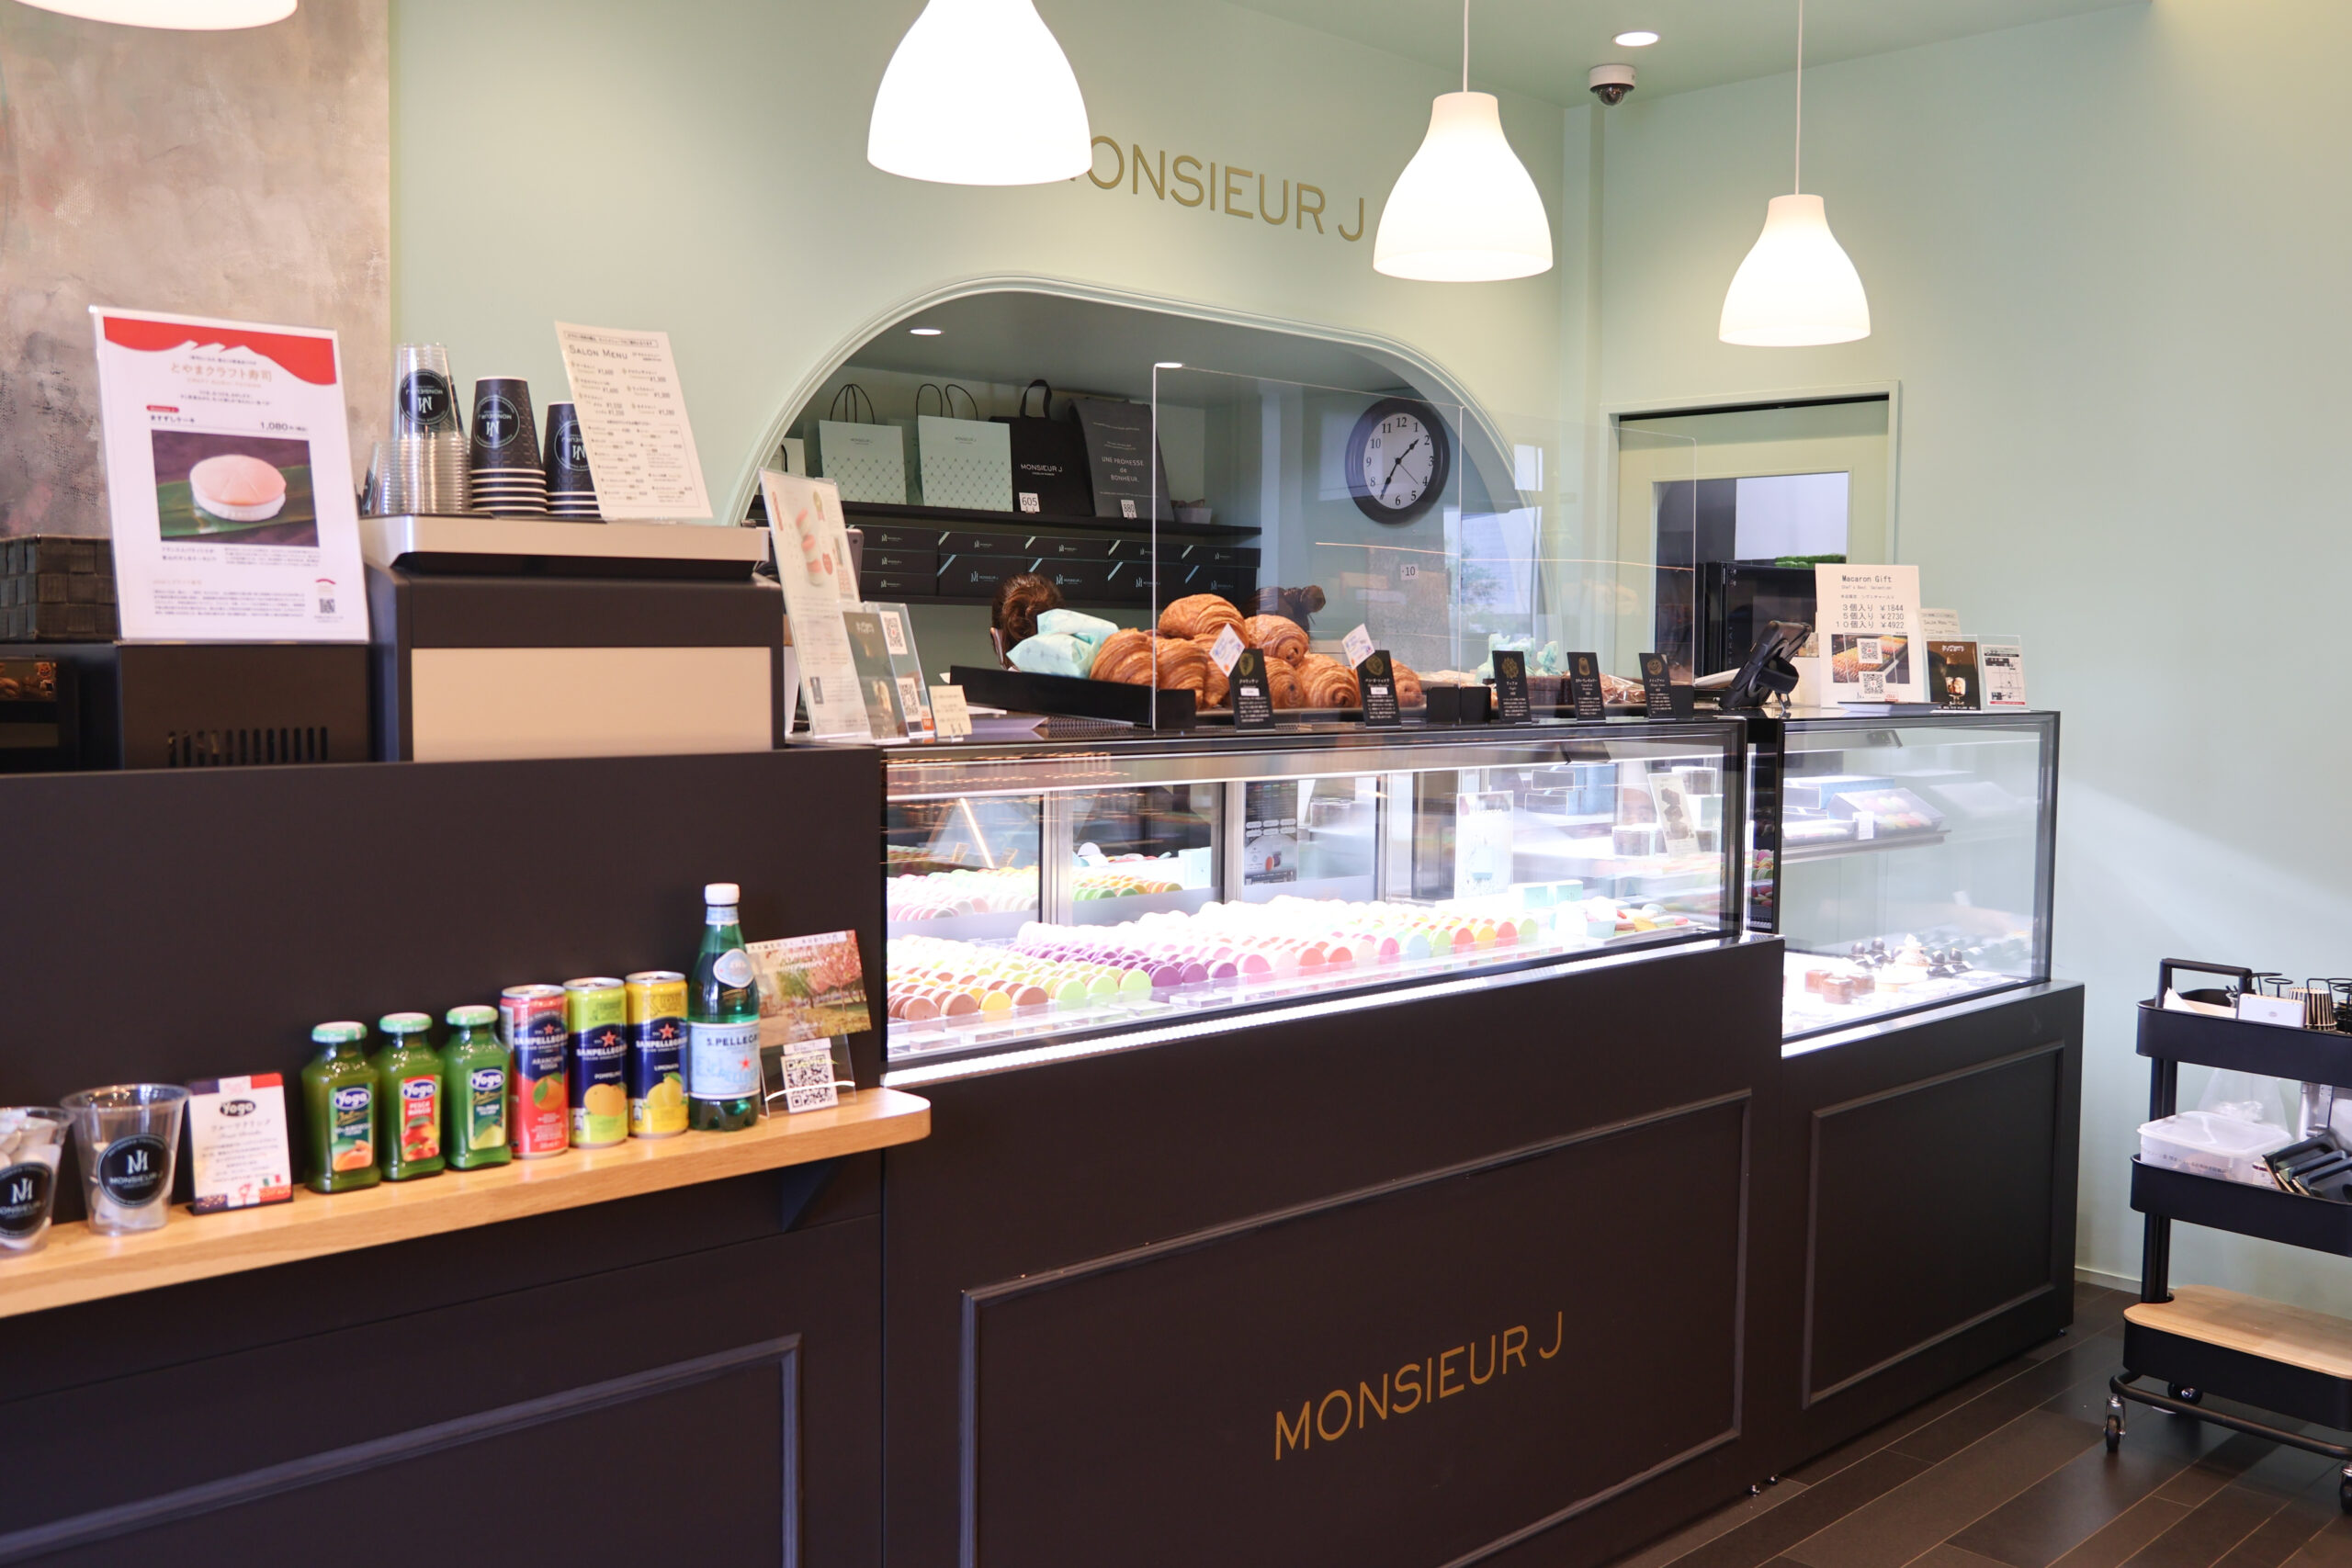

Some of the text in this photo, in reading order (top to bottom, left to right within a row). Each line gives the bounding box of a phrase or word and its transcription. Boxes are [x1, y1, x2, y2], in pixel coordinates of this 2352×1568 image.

[1070, 135, 1364, 242] ONSIEUR J
[1396, 417, 1408, 428] 12
[1413, 423, 1419, 433] 1
[1382, 423, 1392, 434] 11
[1371, 438, 1382, 449] 10
[1424, 434, 1430, 446] 2
[1366, 457, 1372, 467] 9
[1428, 456, 1433, 467] 3
[1021, 463, 1057, 472] MONSIEUR
[1370, 477, 1375, 487] 8
[1422, 476, 1428, 487] 4
[1022, 496, 1038, 506] 605
[1395, 495, 1401, 505] 6
[1411, 491, 1417, 501] 5
[1874, 575, 1893, 583] Gift
[472, 1073, 503, 1089] Yoga
[402, 1083, 434, 1099] Yoga
[334, 1091, 368, 1107] Yoga
[1275, 1311, 1563, 1461] MONSIEUR J
